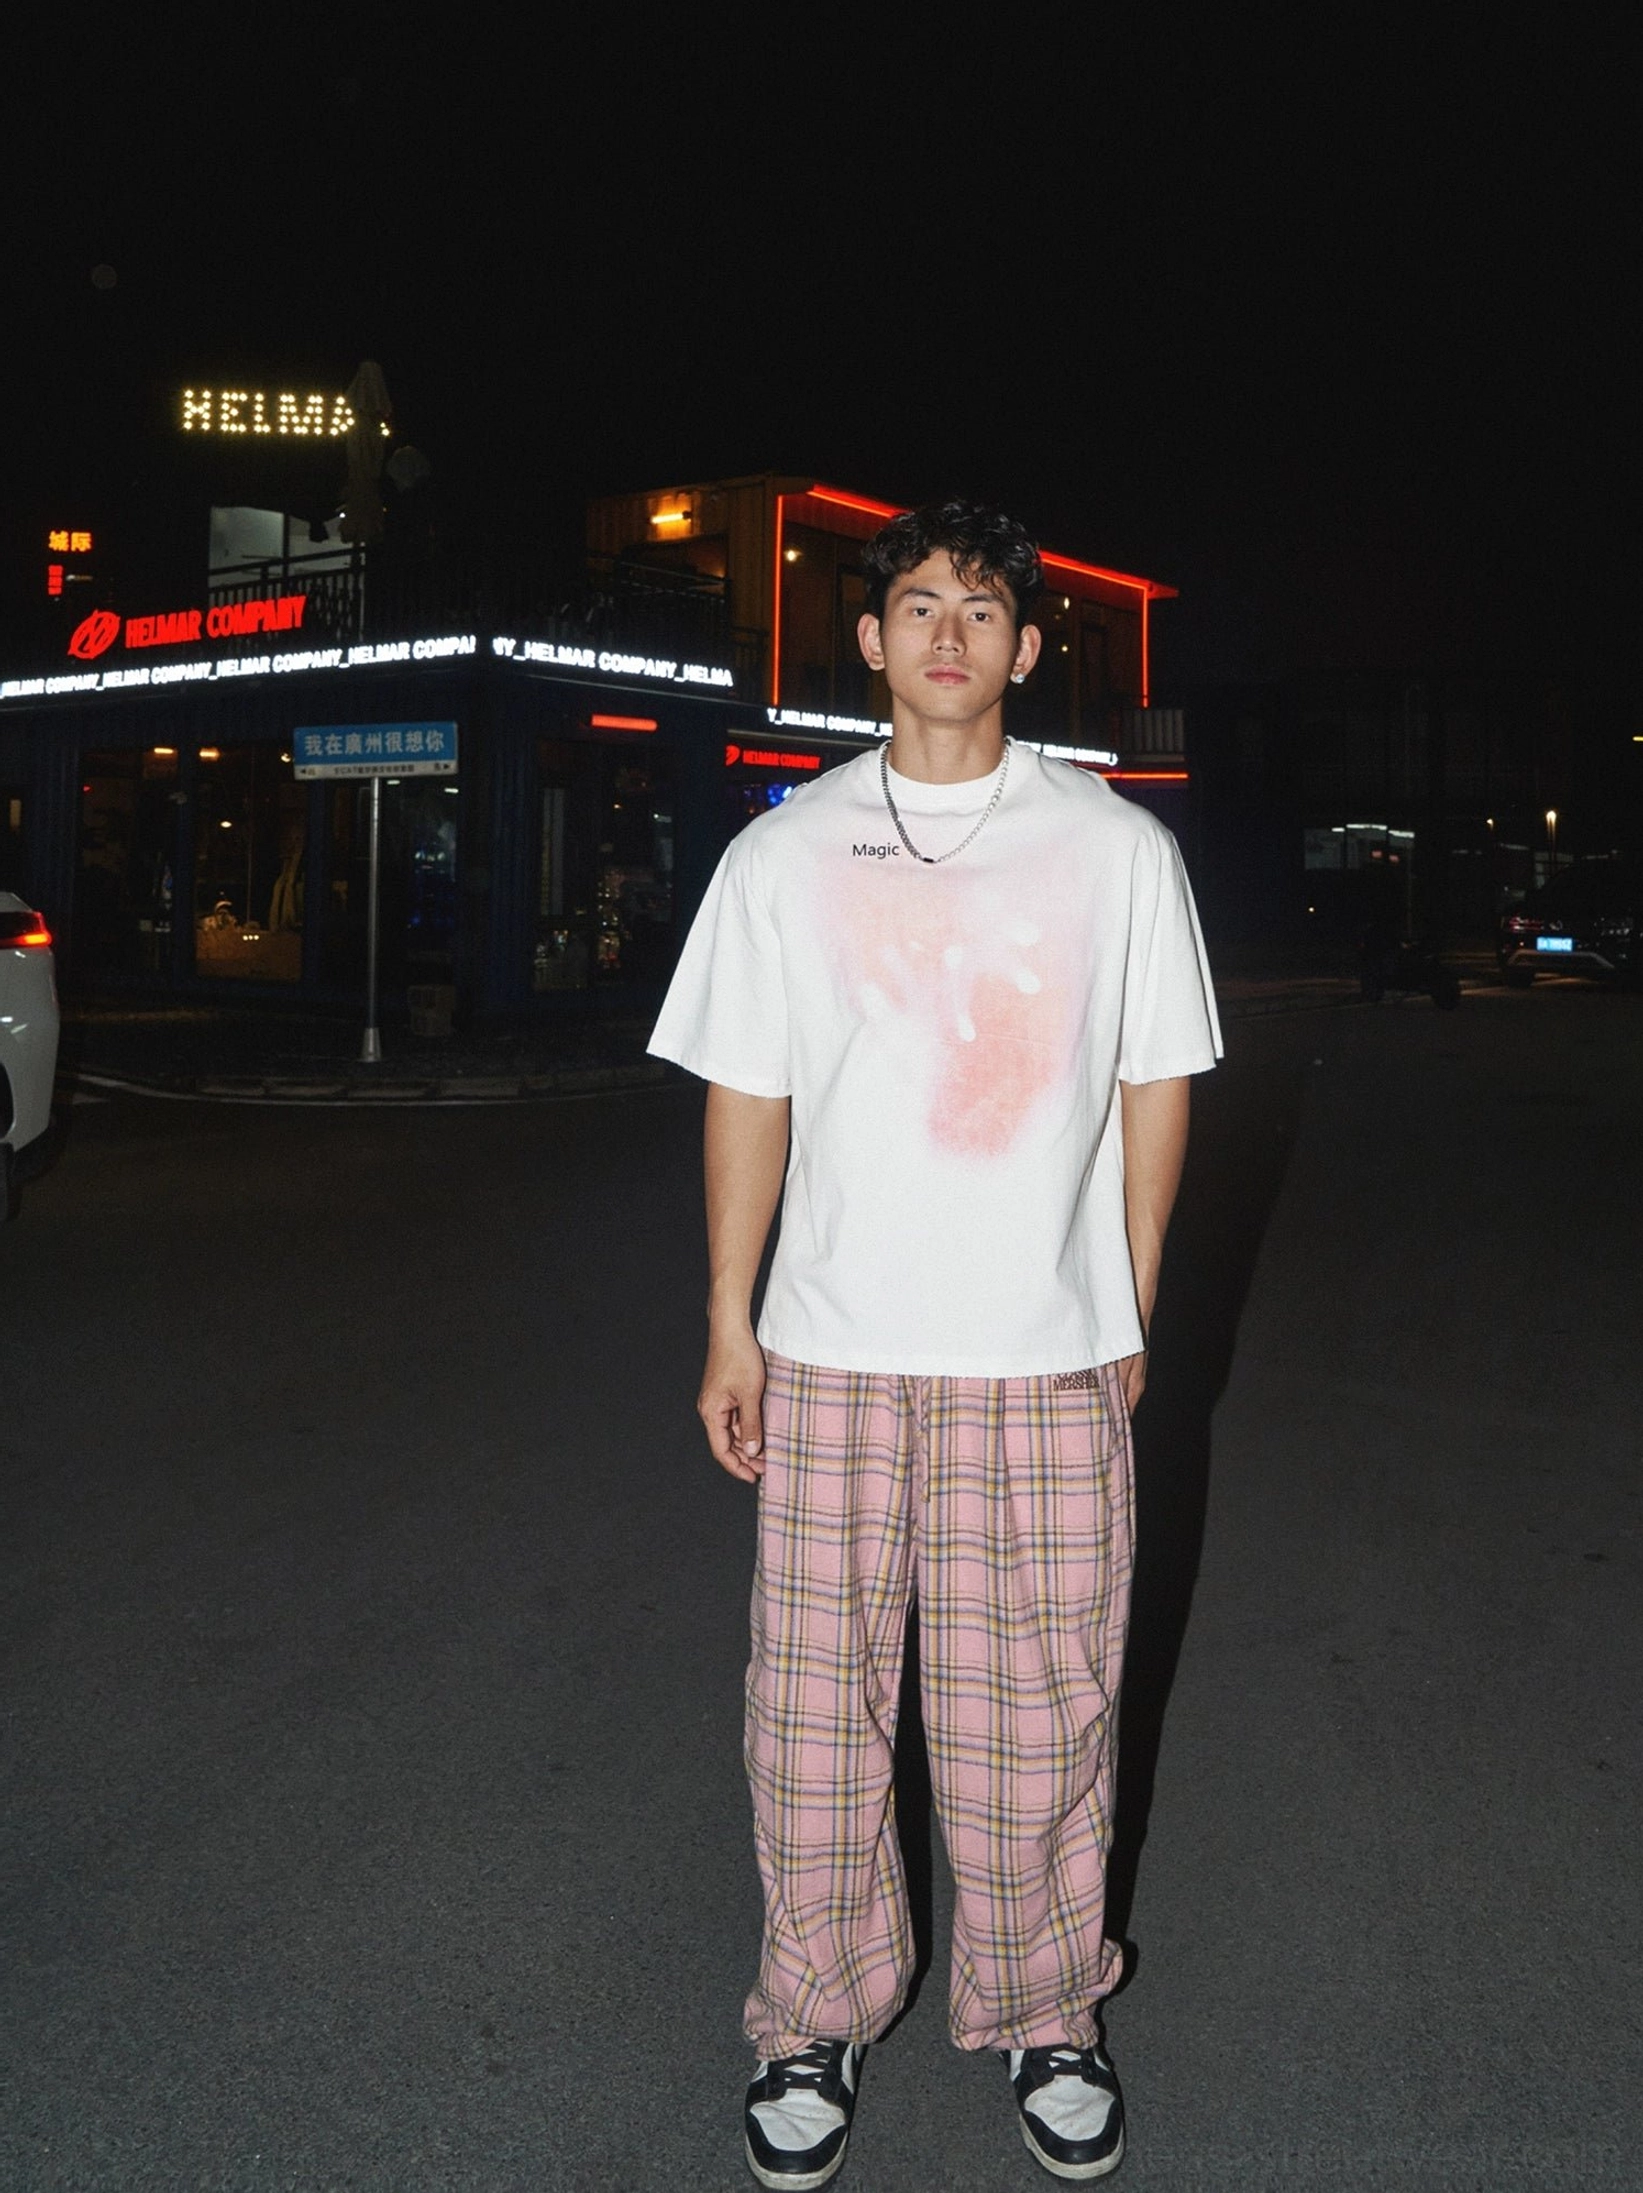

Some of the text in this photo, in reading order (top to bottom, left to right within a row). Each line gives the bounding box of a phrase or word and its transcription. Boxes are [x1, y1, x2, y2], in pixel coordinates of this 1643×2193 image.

[183, 389, 390, 436] HELMA
[125, 595, 306, 648] HELMAR COMPANY
[304, 729, 445, 756] 我在廣州很想你
[852, 843, 900, 860] Magic
